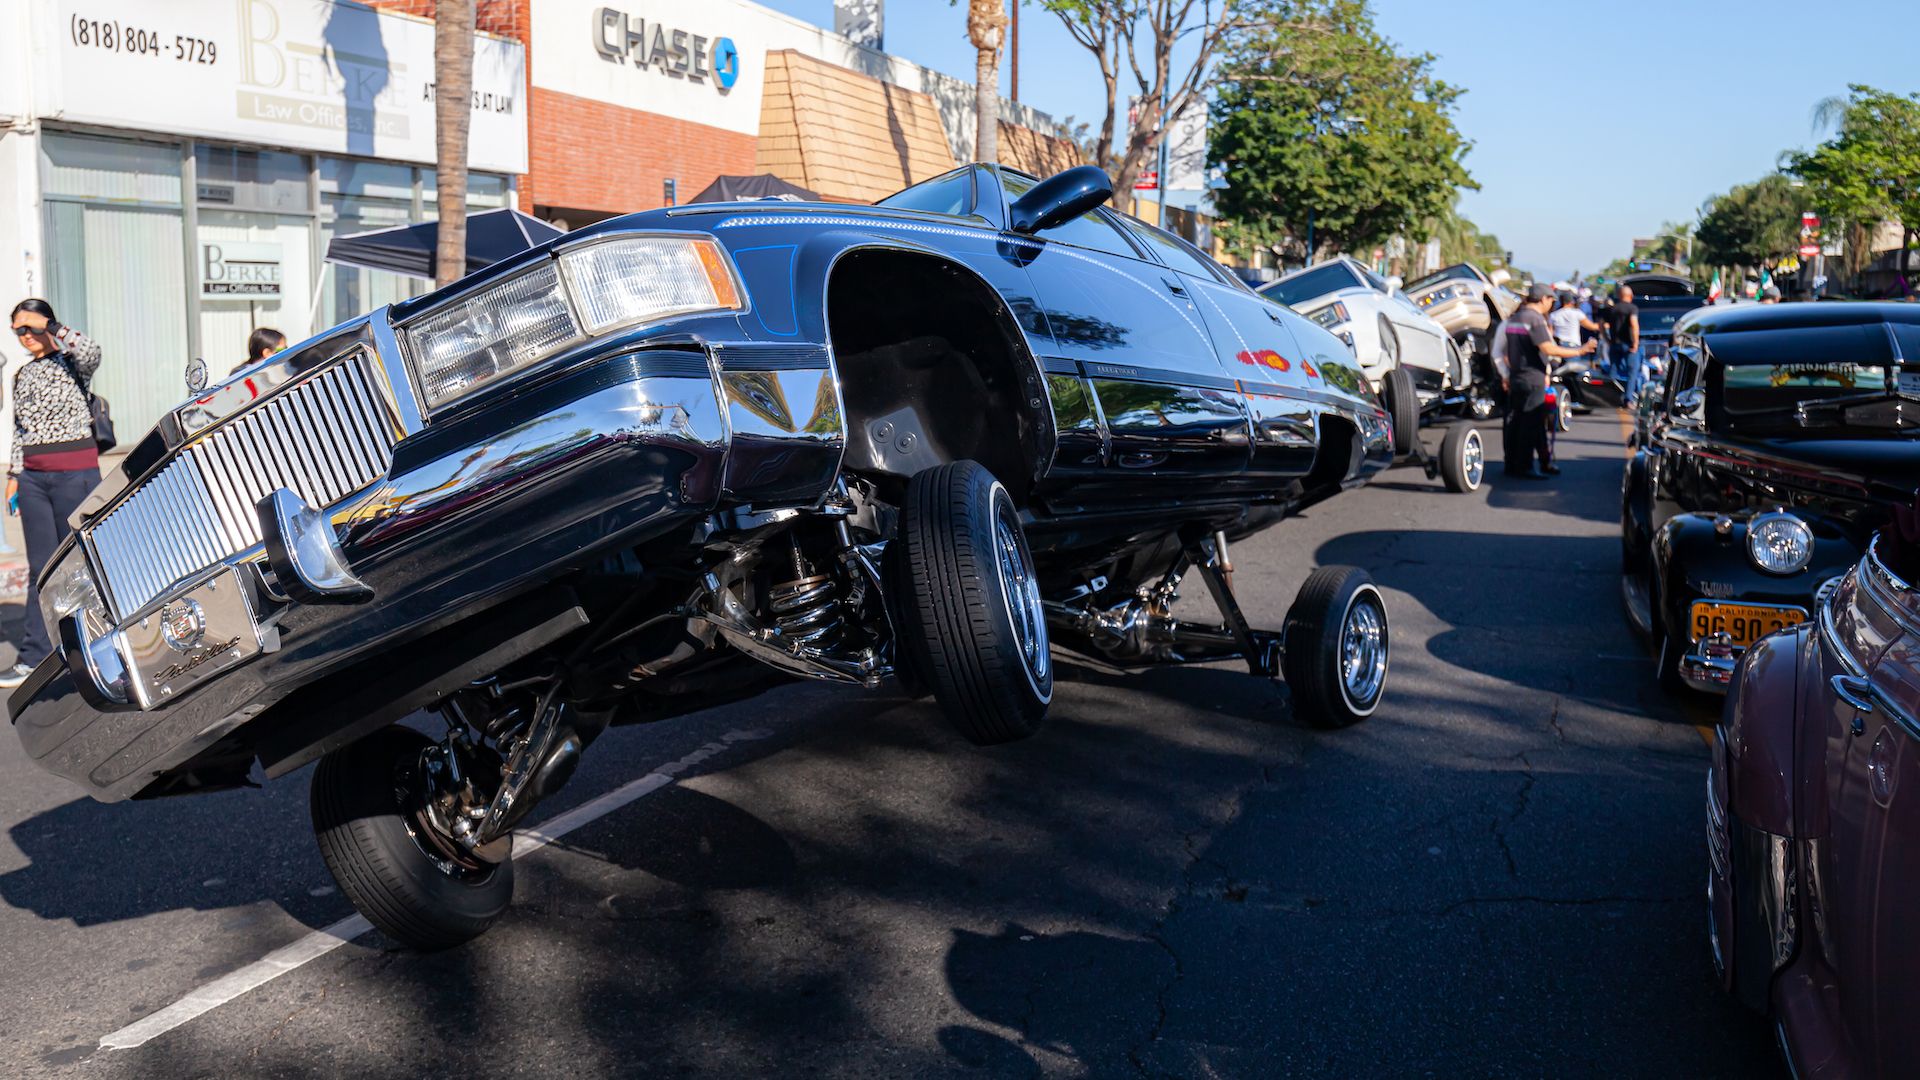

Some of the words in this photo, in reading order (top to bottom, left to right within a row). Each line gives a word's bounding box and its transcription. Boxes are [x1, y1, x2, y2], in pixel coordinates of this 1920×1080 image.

[71, 13, 120, 53] (818)
[126, 27, 159, 56] 804
[176, 35, 217, 65] 5729
[593, 7, 708, 78] CHASE
[254, 95, 293, 119] Law
[372, 118, 400, 136] nc.
[202, 244, 280, 281] BERKE
[1720, 608, 1777, 617] CALIFORNIA
